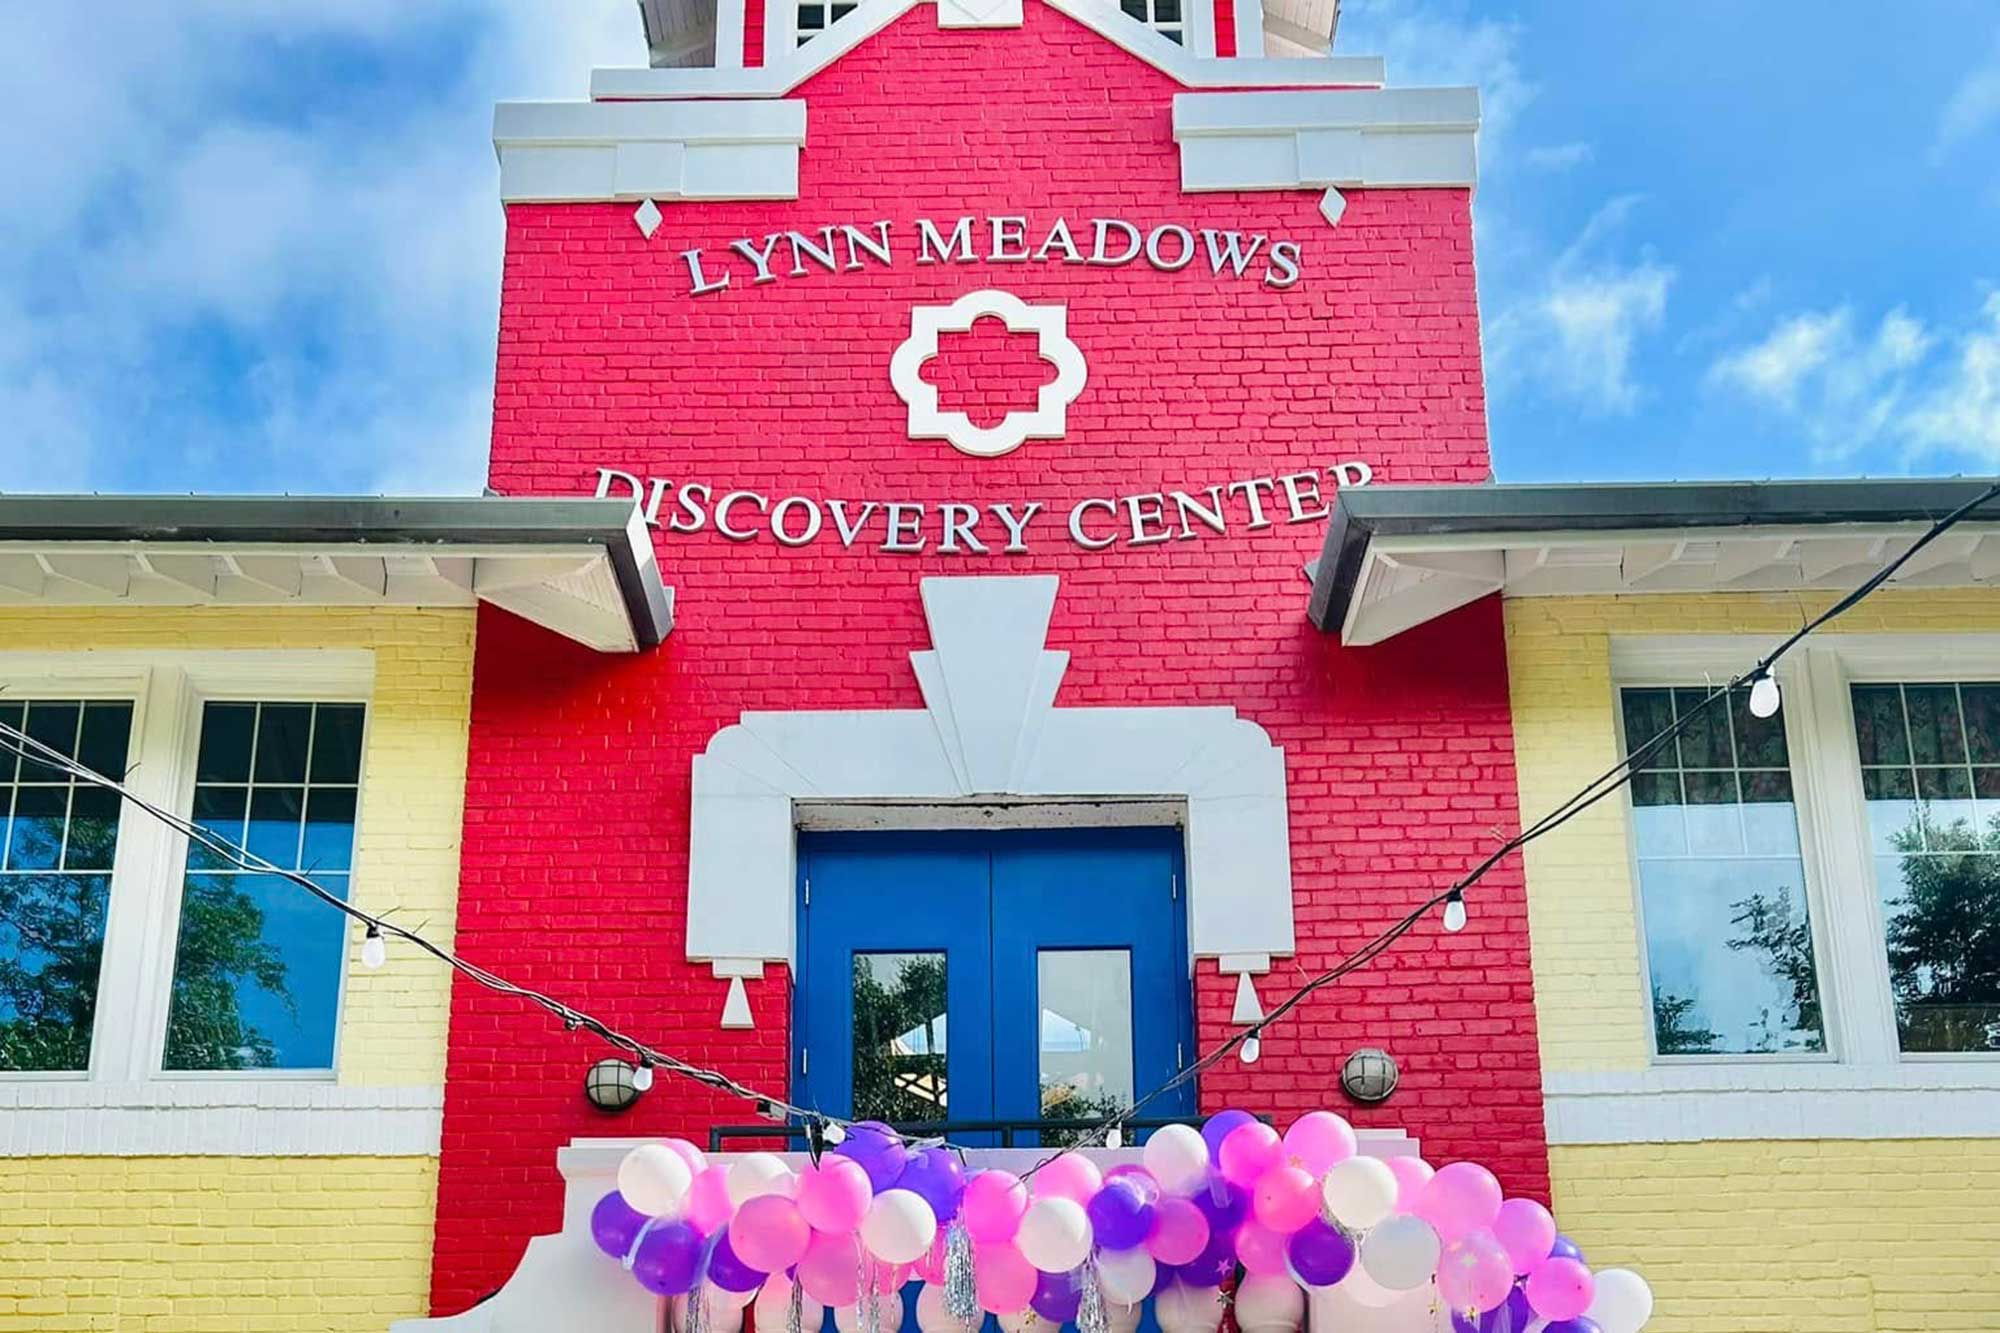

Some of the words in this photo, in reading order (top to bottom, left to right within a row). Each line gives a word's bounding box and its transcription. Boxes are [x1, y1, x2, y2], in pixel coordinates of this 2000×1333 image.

[680, 220, 893, 297] LYNN
[915, 215, 1301, 288] MEADOWS
[595, 467, 1044, 554] DISCOVERY
